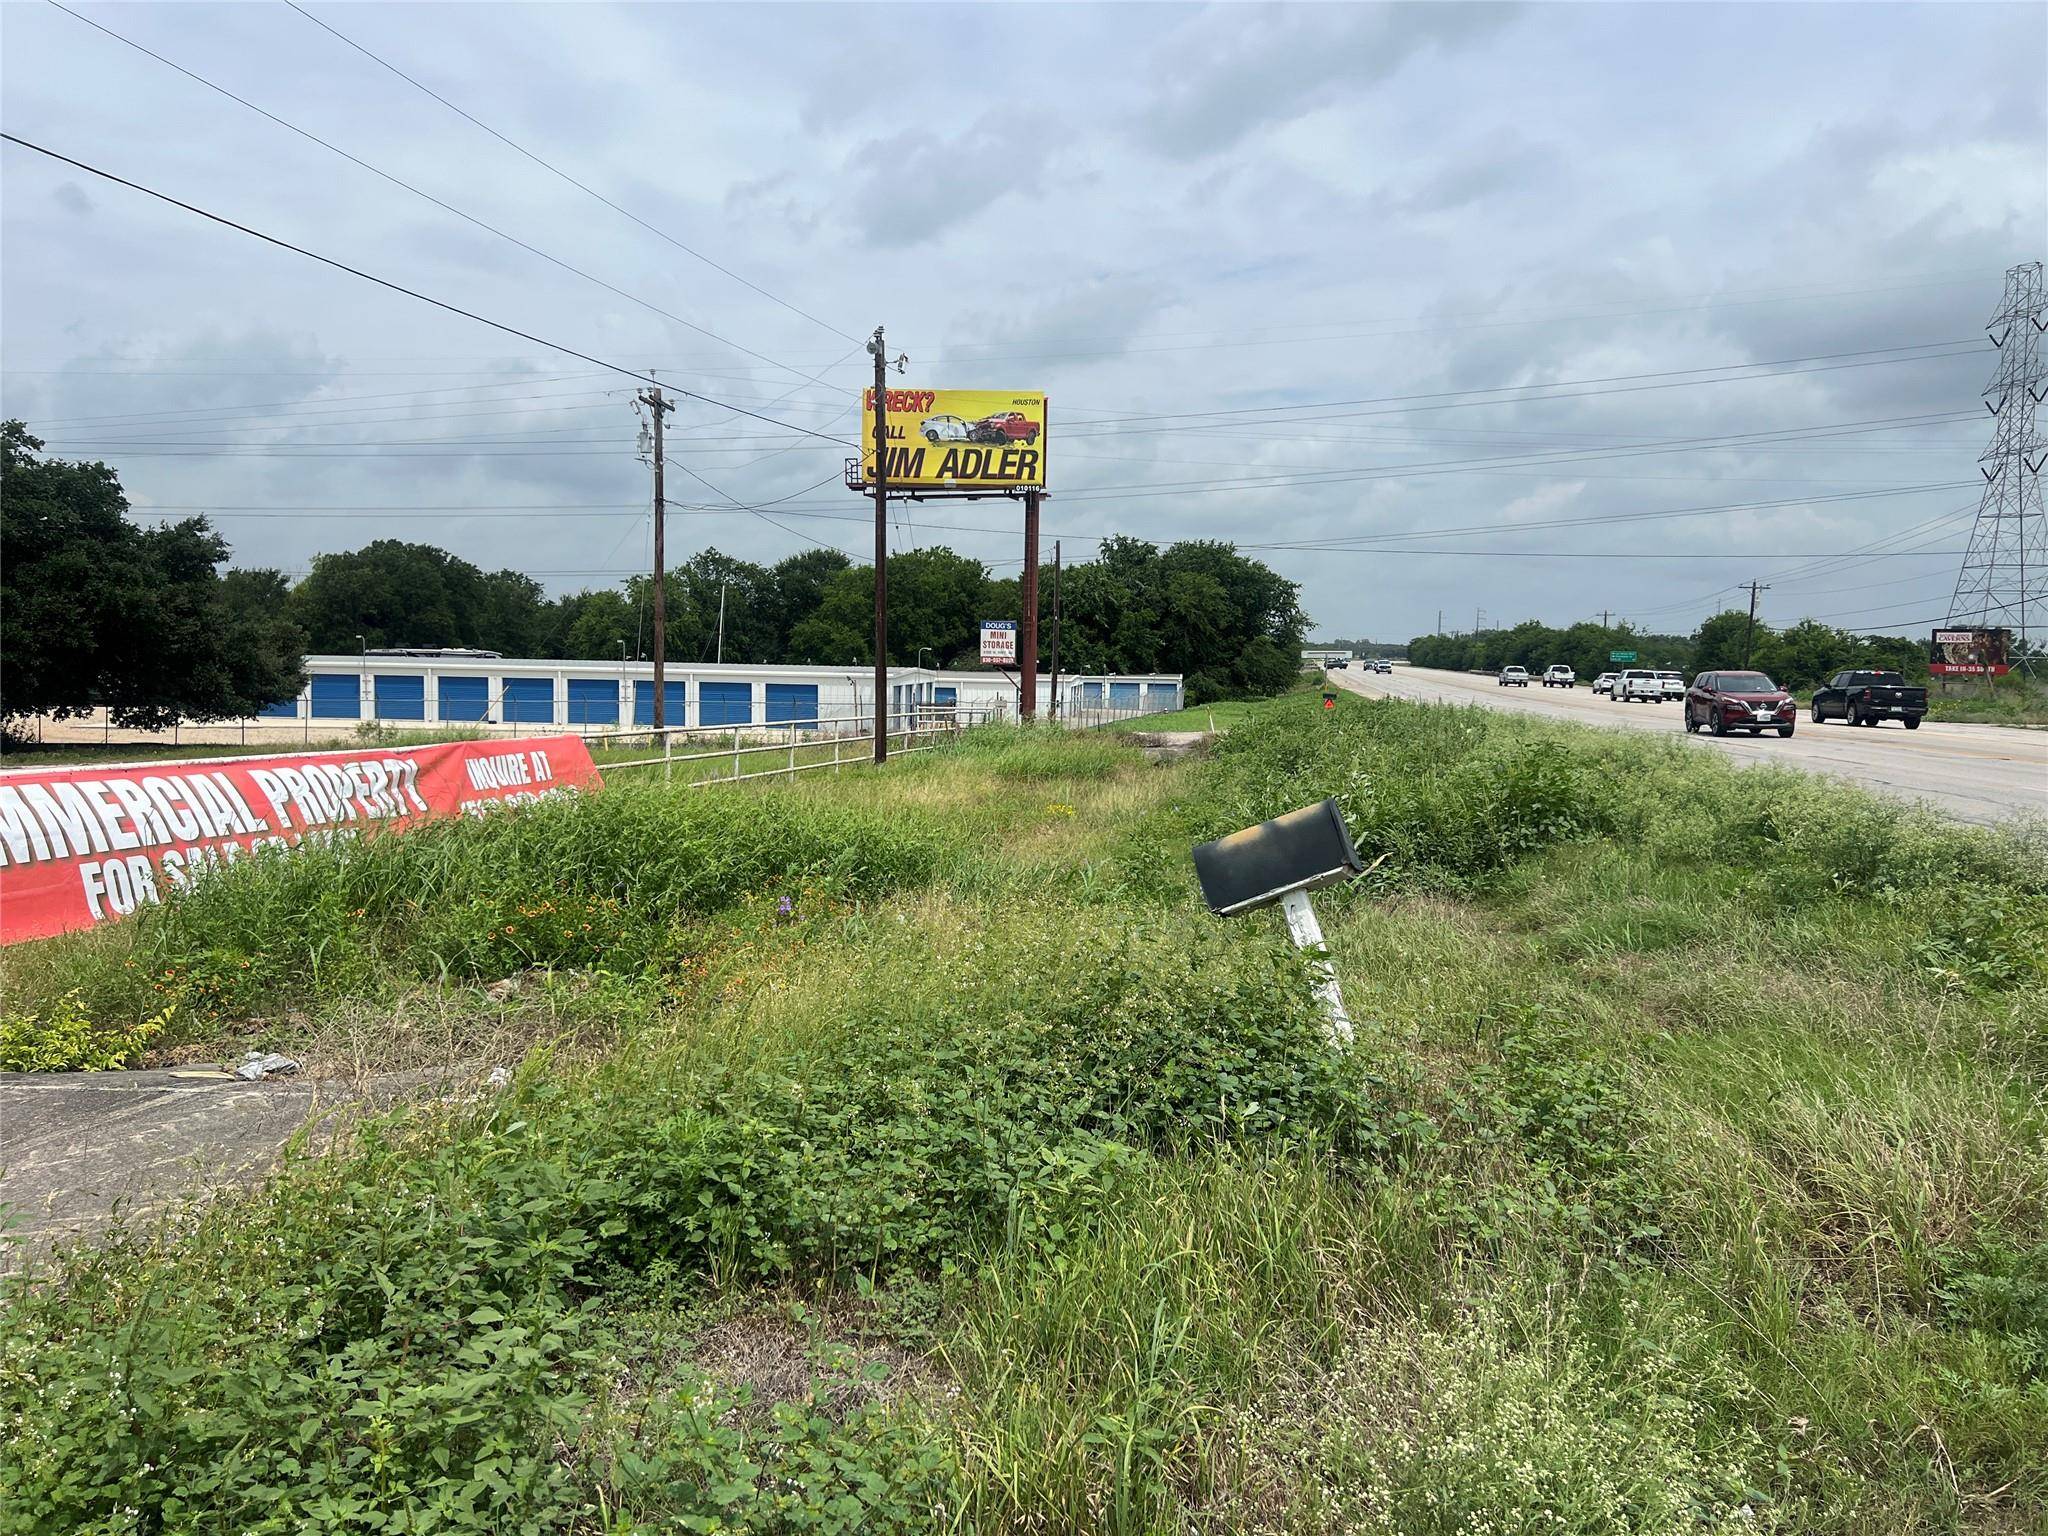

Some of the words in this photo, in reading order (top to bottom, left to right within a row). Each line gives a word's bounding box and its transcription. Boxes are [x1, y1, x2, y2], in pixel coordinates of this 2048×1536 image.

[866, 390, 935, 413] WRECK?
[936, 448, 1039, 480] ADLER
[982, 641, 1014, 649] STORAGE
[990, 631, 1007, 639] MINI
[465, 752, 532, 791] INQUIRE
[0, 772, 268, 866] MMERCIAL
[250, 758, 428, 829] PROPERTY
[79, 855, 160, 920] FOR
